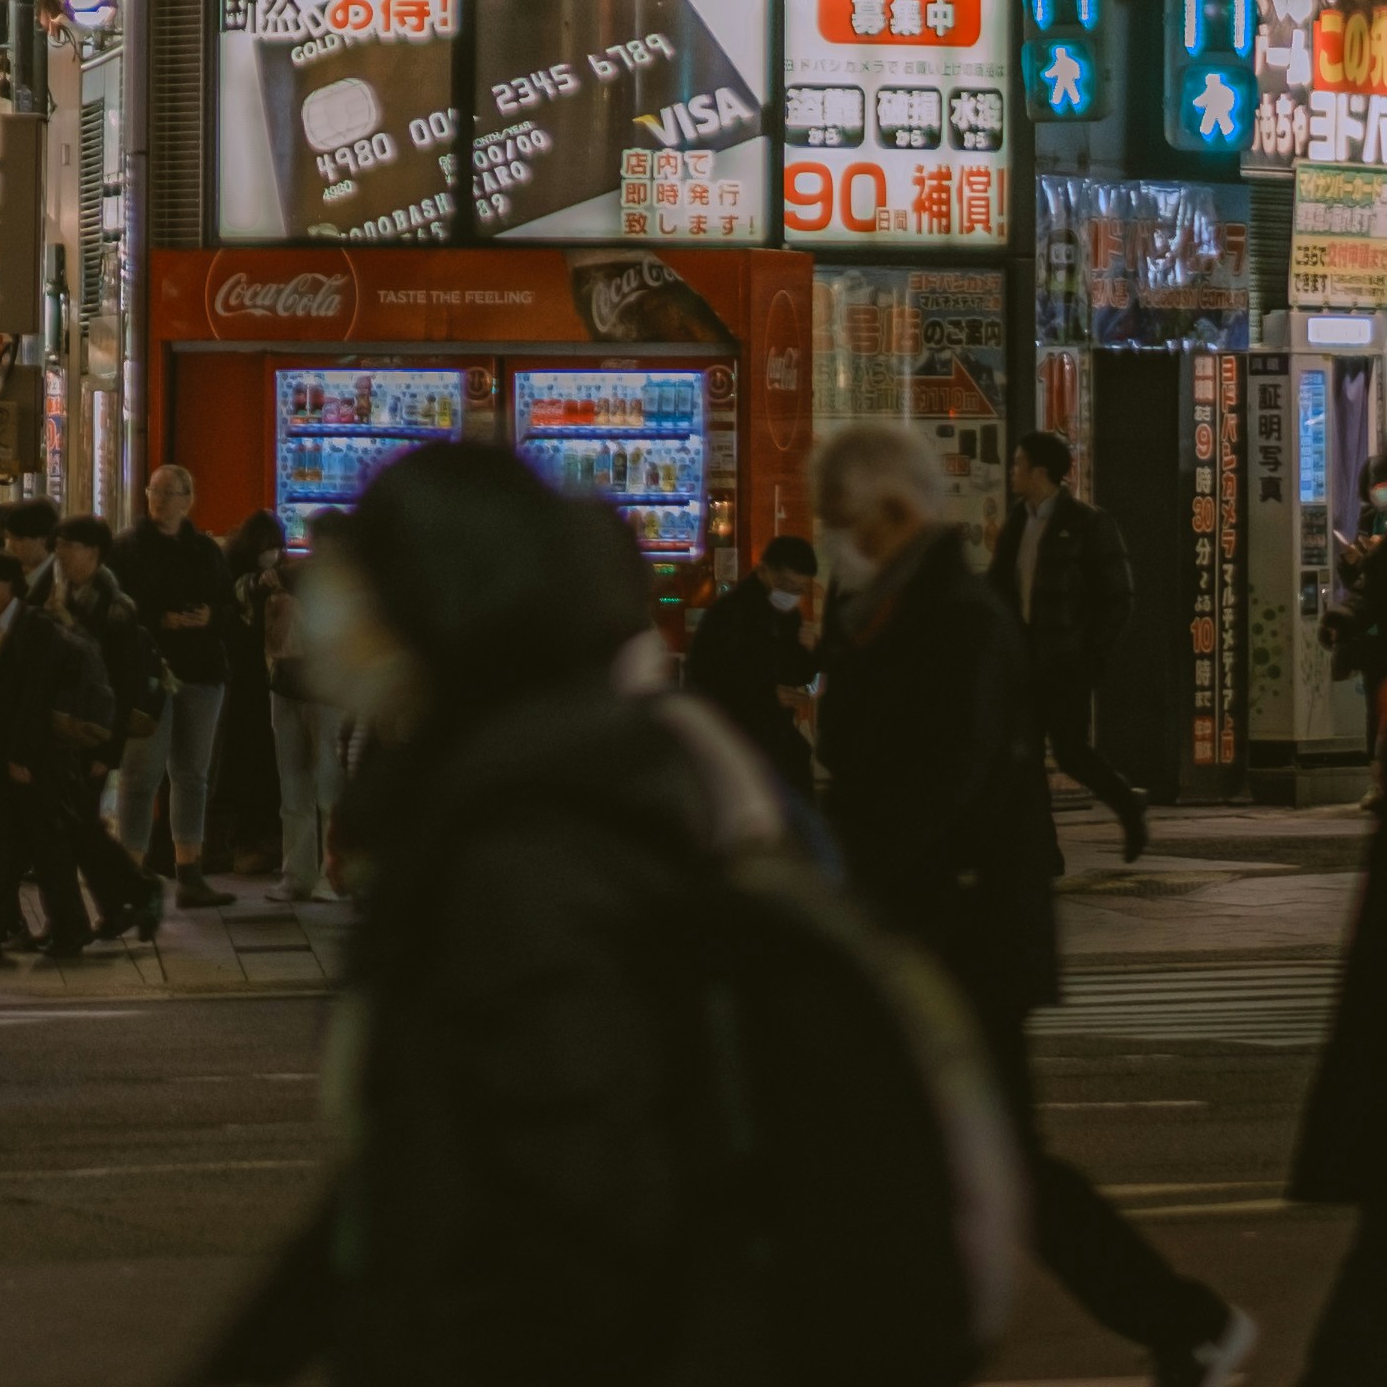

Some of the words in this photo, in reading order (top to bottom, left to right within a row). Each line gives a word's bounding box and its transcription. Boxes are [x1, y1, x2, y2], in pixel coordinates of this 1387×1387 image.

[492, 63, 573, 113] 2345
[587, 33, 673, 78] 6789
[633, 87, 755, 147] VISA
[317, 132, 394, 182] 4980
[626, 152, 710, 176] 店内で
[625, 181, 740, 207] 即時発行
[214, 271, 349, 317] Coca-Cola
[377, 289, 426, 305] TASTE
[430, 290, 461, 305] THE
[465, 290, 533, 305] FEELING
[1258, 384, 1283, 503] 証明写真
